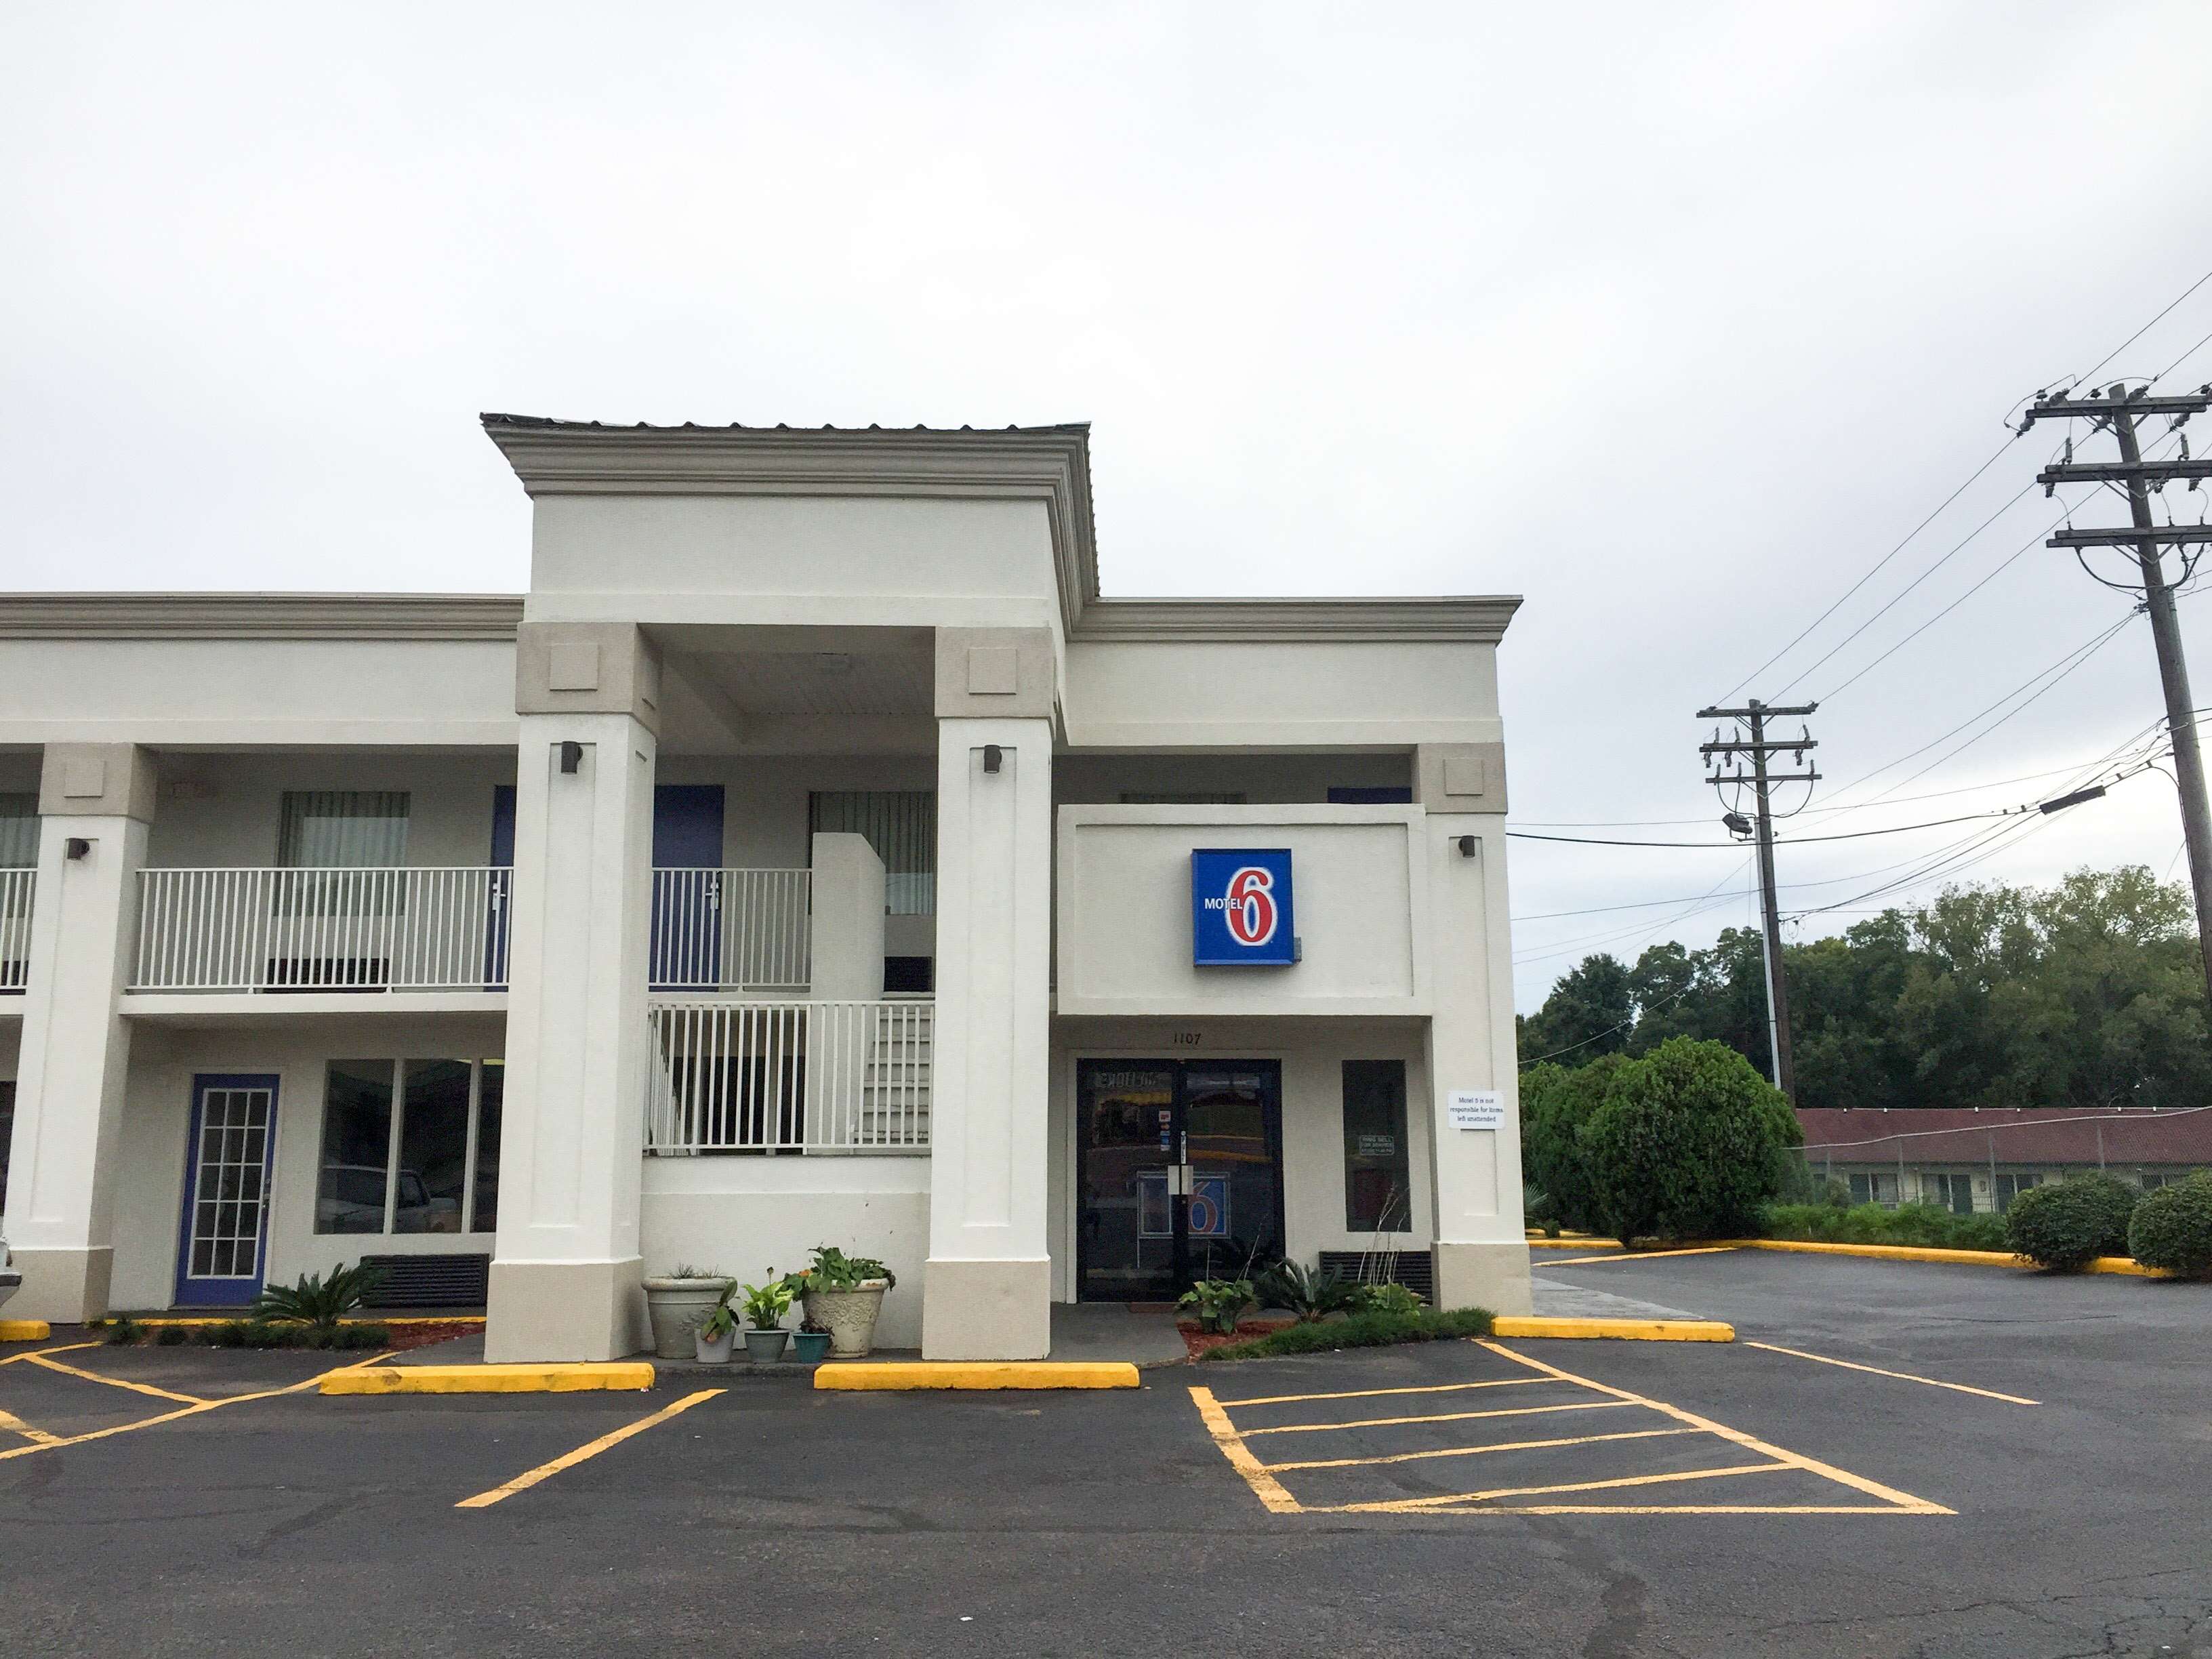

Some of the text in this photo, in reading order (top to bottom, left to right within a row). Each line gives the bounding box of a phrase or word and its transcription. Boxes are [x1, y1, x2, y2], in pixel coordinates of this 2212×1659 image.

[1204, 867, 1277, 946] MOTEL 6
[1173, 1033, 1202, 1045] 1107
